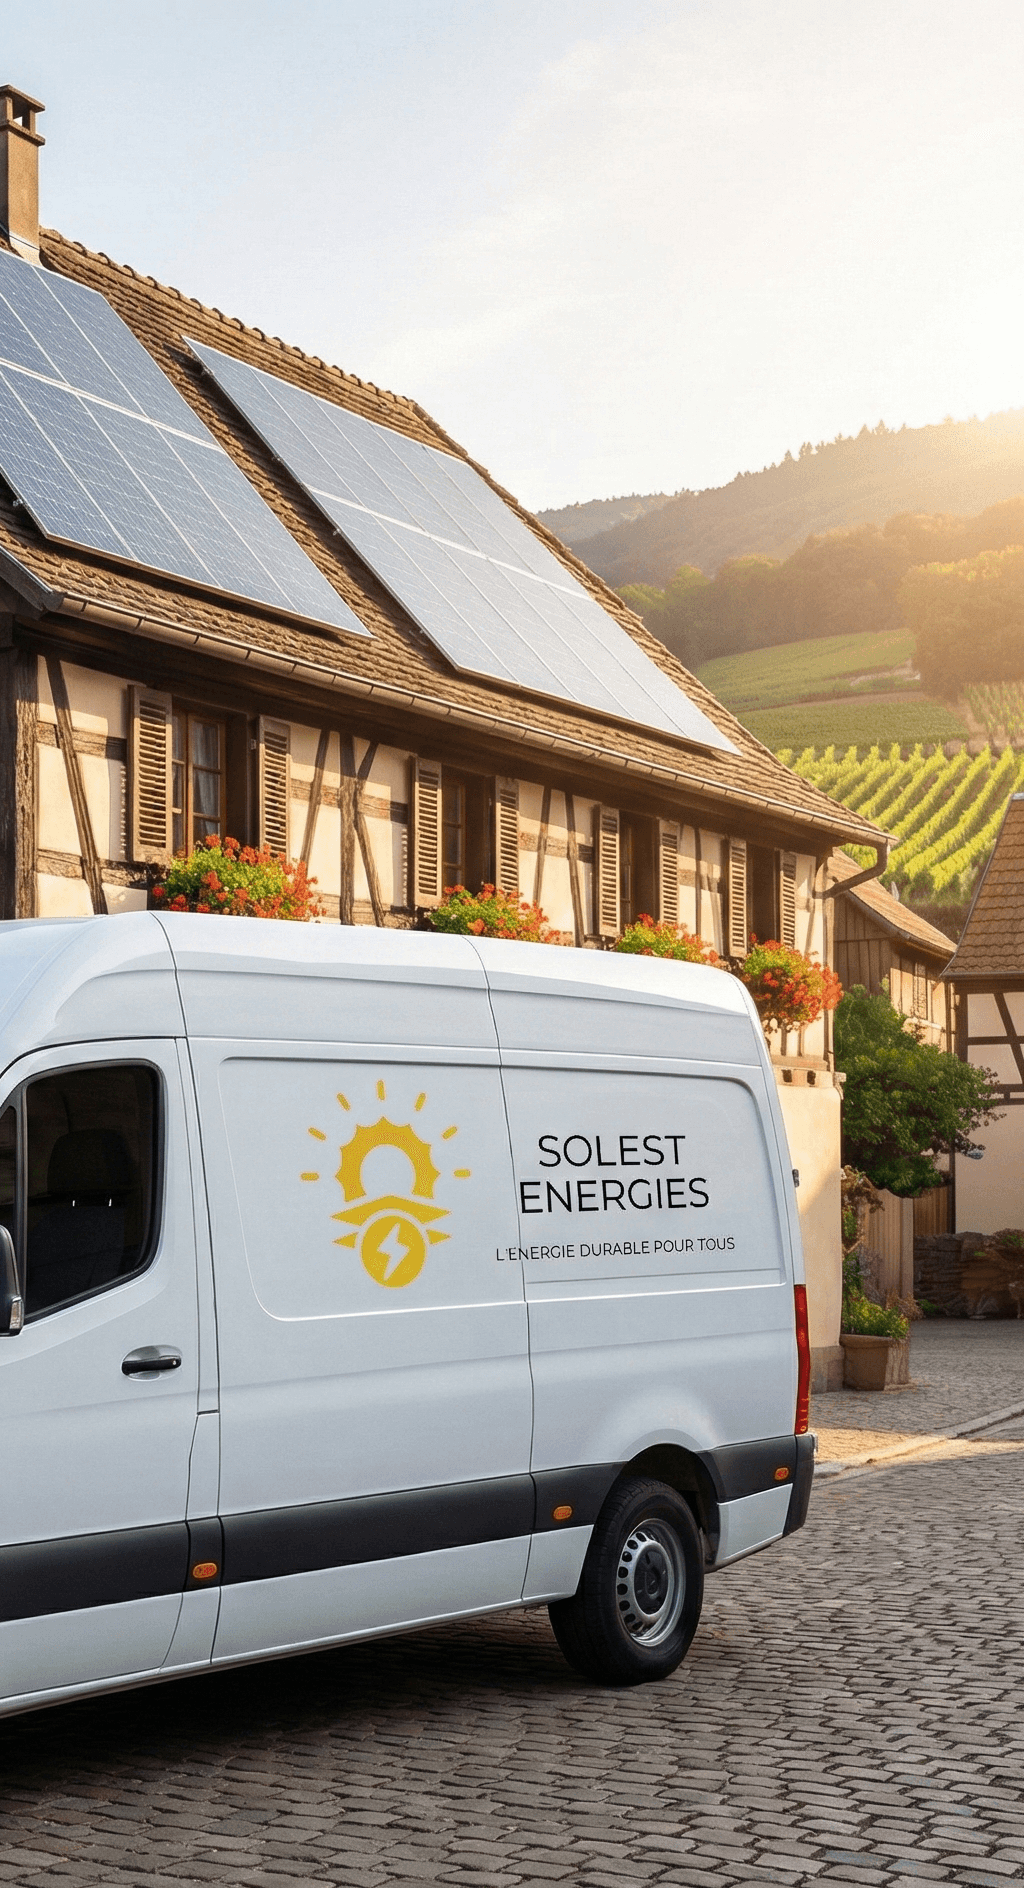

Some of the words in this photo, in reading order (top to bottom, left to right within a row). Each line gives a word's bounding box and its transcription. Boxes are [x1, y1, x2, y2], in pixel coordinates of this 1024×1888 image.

[538, 1135, 686, 1167] SOLEST
[519, 1177, 710, 1214] ENERGIES
[496, 1244, 576, 1261] L'ENERGIE
[580, 1240, 650, 1257] DURABLE
[654, 1239, 694, 1253] POUR
[697, 1237, 735, 1250] TOUS
